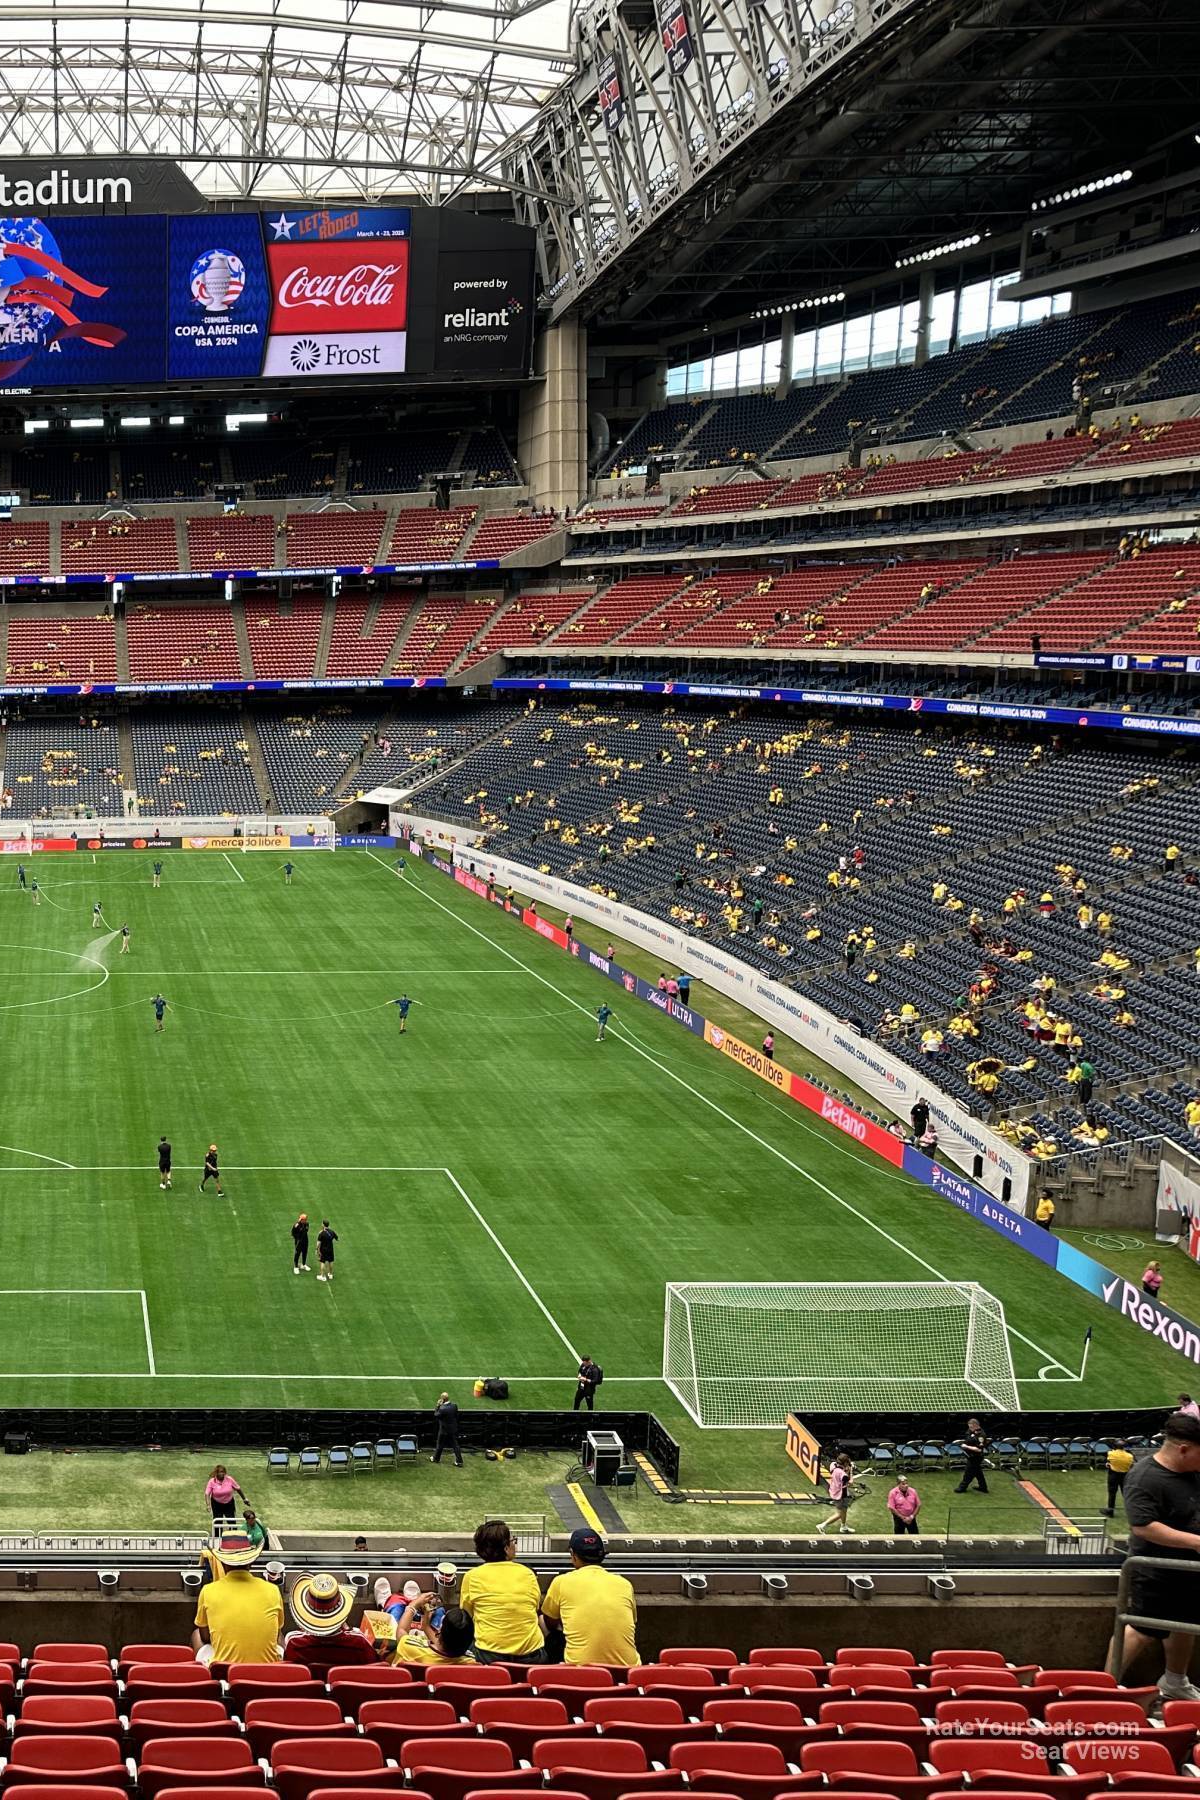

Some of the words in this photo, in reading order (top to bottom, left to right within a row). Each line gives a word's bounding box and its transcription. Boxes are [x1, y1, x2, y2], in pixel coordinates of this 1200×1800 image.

[300, 211, 329, 235] LET'S
[319, 211, 359, 239] RODEO
[279, 265, 402, 308] Coca-Cola
[452, 279, 495, 291] powered
[496, 279, 508, 290] by
[444, 308, 510, 328] reliant
[175, 325, 204, 337] COPA
[207, 324, 259, 336] AMERICA
[195, 338, 213, 346] USA
[216, 337, 237, 346] 2024
[443, 335, 453, 343] an
[454, 333, 472, 342] NRG
[473, 333, 509, 343] company
[325, 345, 380, 365] Frost
[211, 838, 256, 847] mercado
[258, 837, 281, 847] libre
[672, 1004, 693, 1027] ULTRA
[725, 1037, 762, 1073] mercado
[763, 1061, 783, 1085] libre
[833, 1034, 856, 1057] CONMEBOL
[856, 1050, 868, 1064] COPA
[867, 1058, 886, 1077] AMERICA
[821, 1095, 866, 1140] Betano
[950, 1119, 963, 1136] COPA
[962, 1130, 987, 1155] AMERICA
[940, 1186, 970, 1210] AIRLINES
[941, 1173, 970, 1199] LATAM
[991, 1209, 1021, 1236] DELTA
